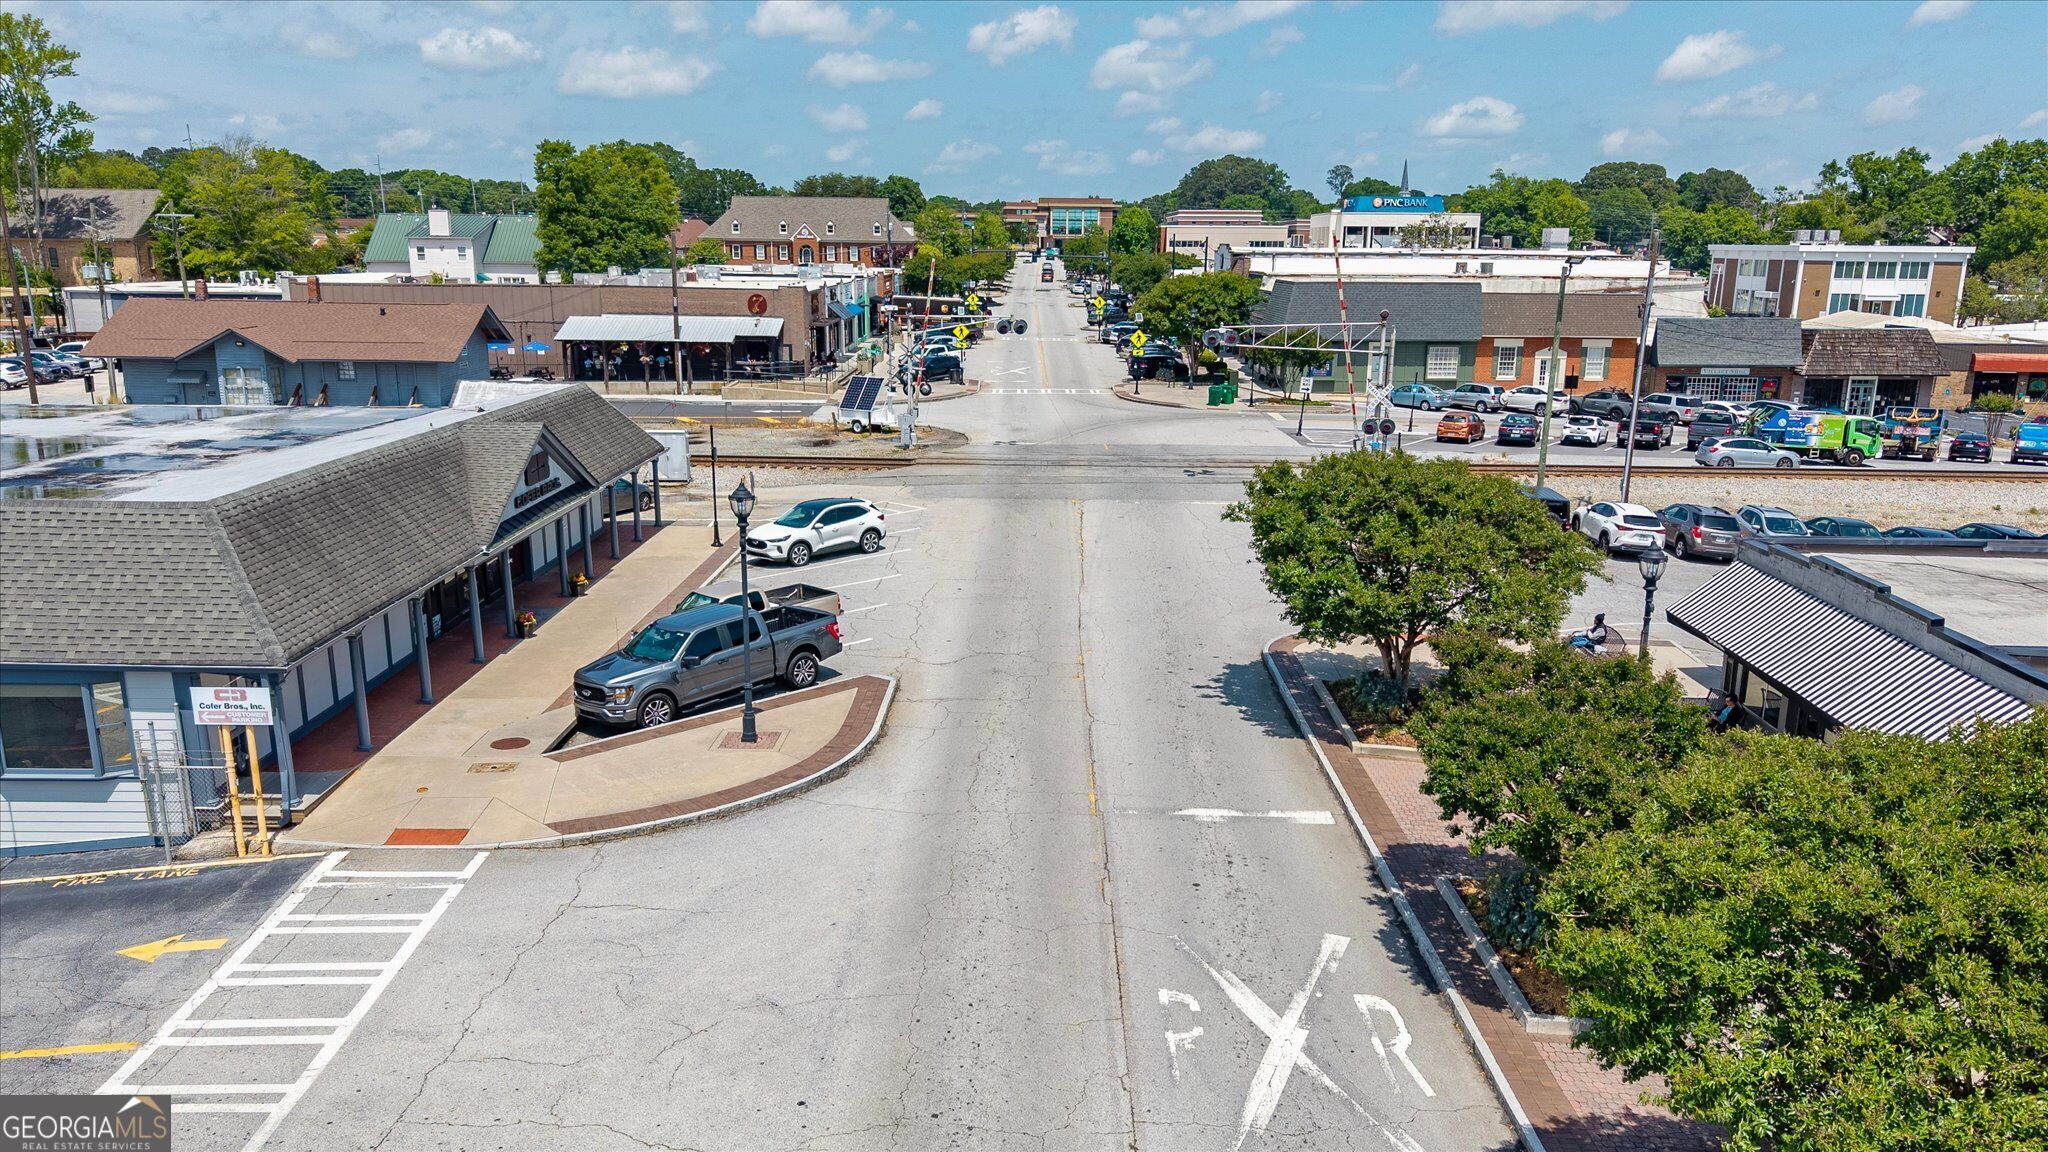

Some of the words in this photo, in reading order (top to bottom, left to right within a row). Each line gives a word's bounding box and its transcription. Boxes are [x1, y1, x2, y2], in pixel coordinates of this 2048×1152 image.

[1383, 198, 1403, 207] PNC
[1404, 198, 1428, 207] BANK
[250, 702, 266, 710] Inc.
[52, 876, 108, 888] FIRE
[132, 867, 202, 881] LANE
